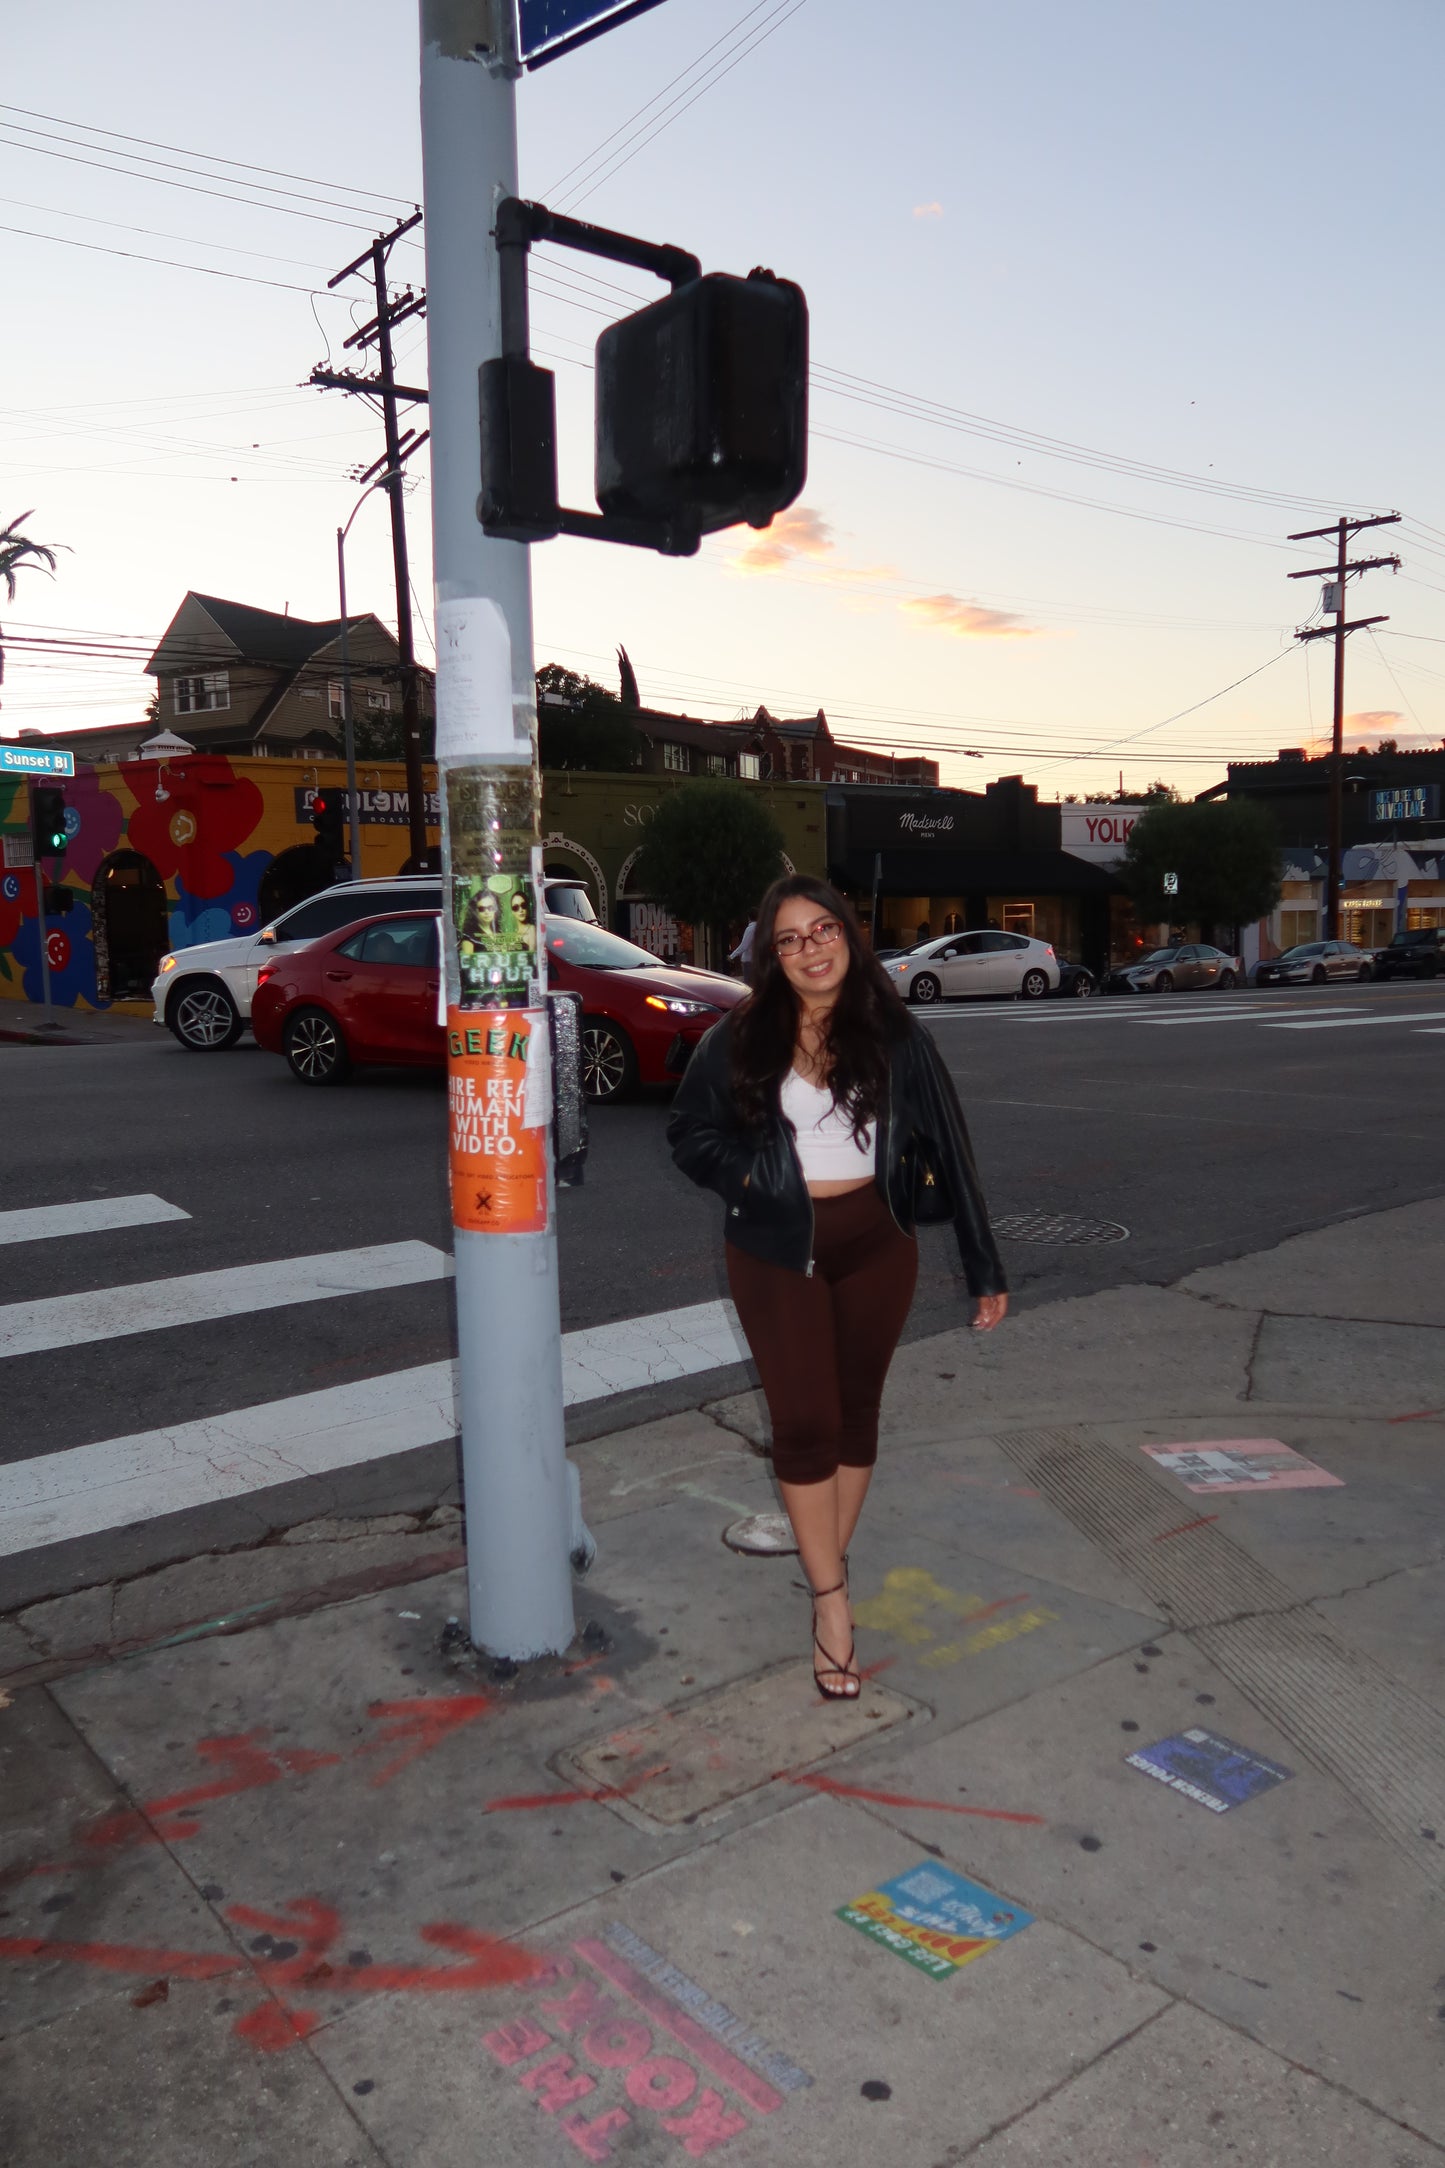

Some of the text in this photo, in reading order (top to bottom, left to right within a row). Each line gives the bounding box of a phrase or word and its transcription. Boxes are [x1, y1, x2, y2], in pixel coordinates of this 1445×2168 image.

[4, 751, 68, 769] Sunset Bl
[370, 816, 438, 824] ROASTRS
[1376, 800, 1426, 820] SILVER LAKE
[899, 812, 954, 832] Madewell
[460, 953, 537, 969] CRUS
[469, 965, 533, 984] HOUR
[448, 1029, 529, 1061] GEEK
[456, 1114, 509, 1136] WITH
[453, 1132, 523, 1155] VIDEO.
[1125, 1754, 1176, 1783] POLICE
[1170, 1778, 1229, 1813] FRENCH
[480, 2016, 632, 2164] THE
